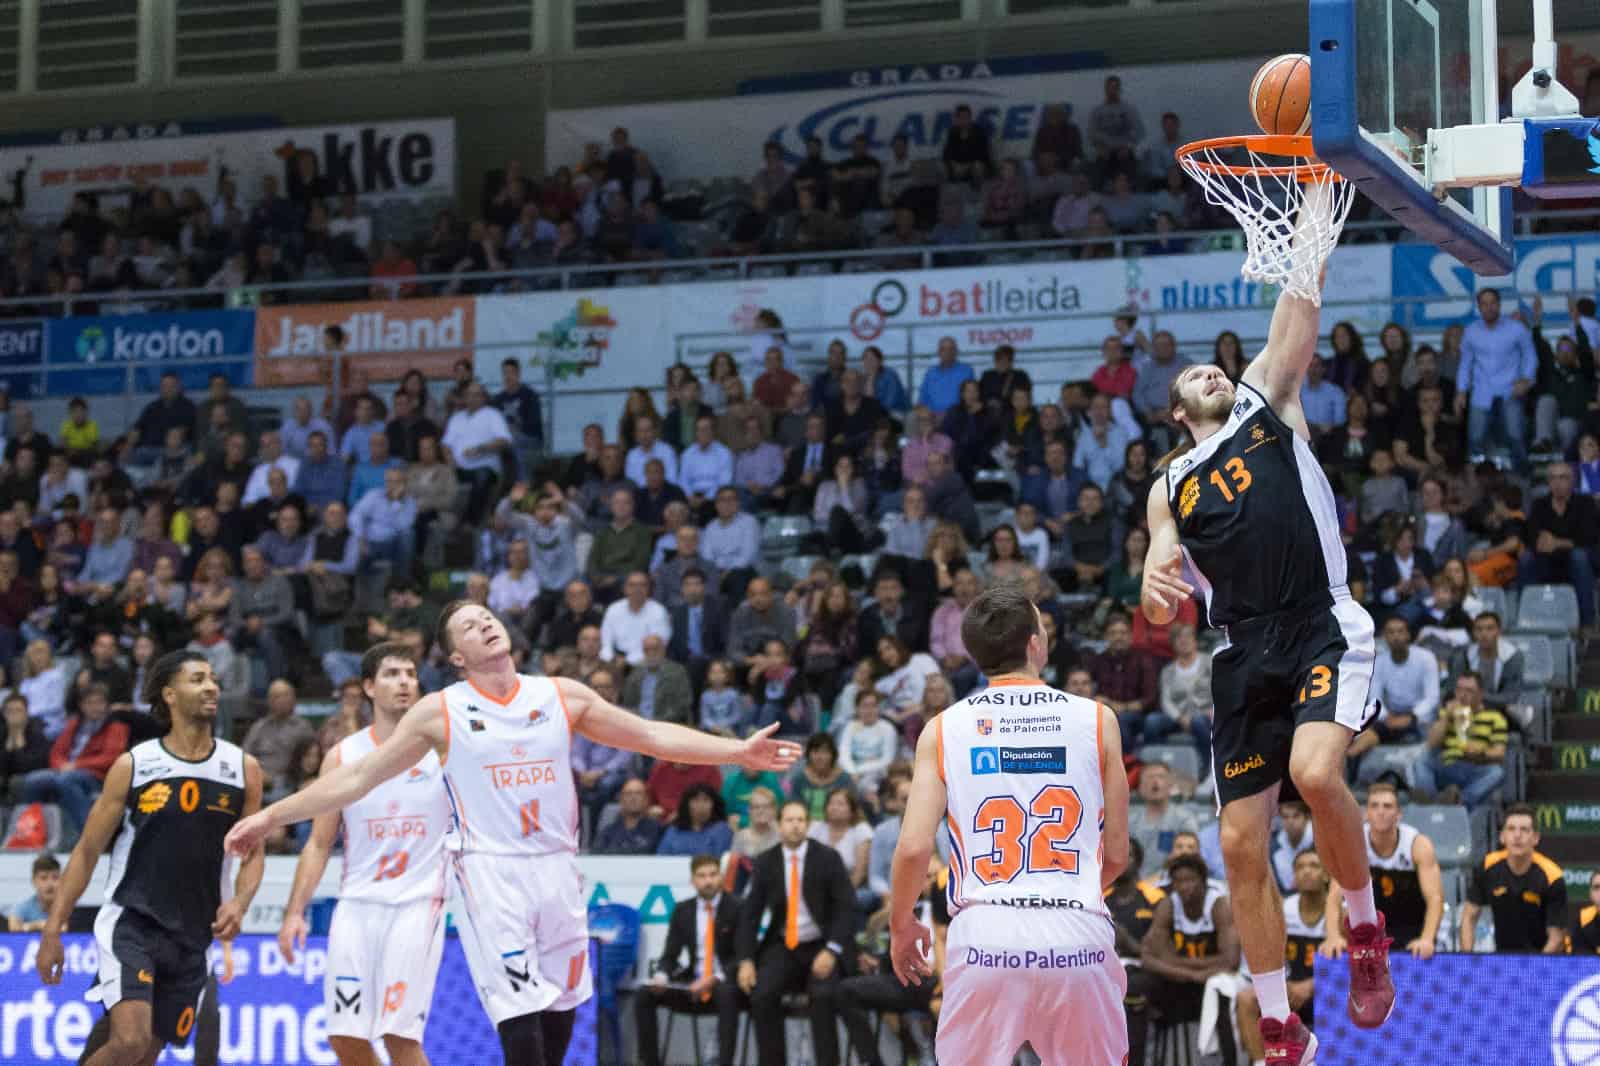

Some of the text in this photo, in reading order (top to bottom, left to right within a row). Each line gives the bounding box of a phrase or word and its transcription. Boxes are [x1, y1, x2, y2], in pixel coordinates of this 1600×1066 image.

[849, 63, 994, 87] GRADA
[323, 127, 434, 192] kke
[919, 277, 1081, 317] batlleida
[0, 329, 39, 355] ENT
[113, 324, 223, 359] kroton
[1209, 456, 1253, 503] 13
[999, 715, 1062, 725] Ayuntamiento
[999, 723, 1062, 733] de Palencia
[1002, 750, 1053, 761] Diputación
[482, 760, 557, 790] TRAPA
[179, 779, 200, 813] 0
[360, 814, 430, 840] TRAPA
[519, 799, 542, 837] 11
[972, 784, 1084, 886] 32
[967, 947, 1106, 969] Diario Palentino
[2, 989, 92, 1061] rte
[176, 1006, 195, 1039] 0
